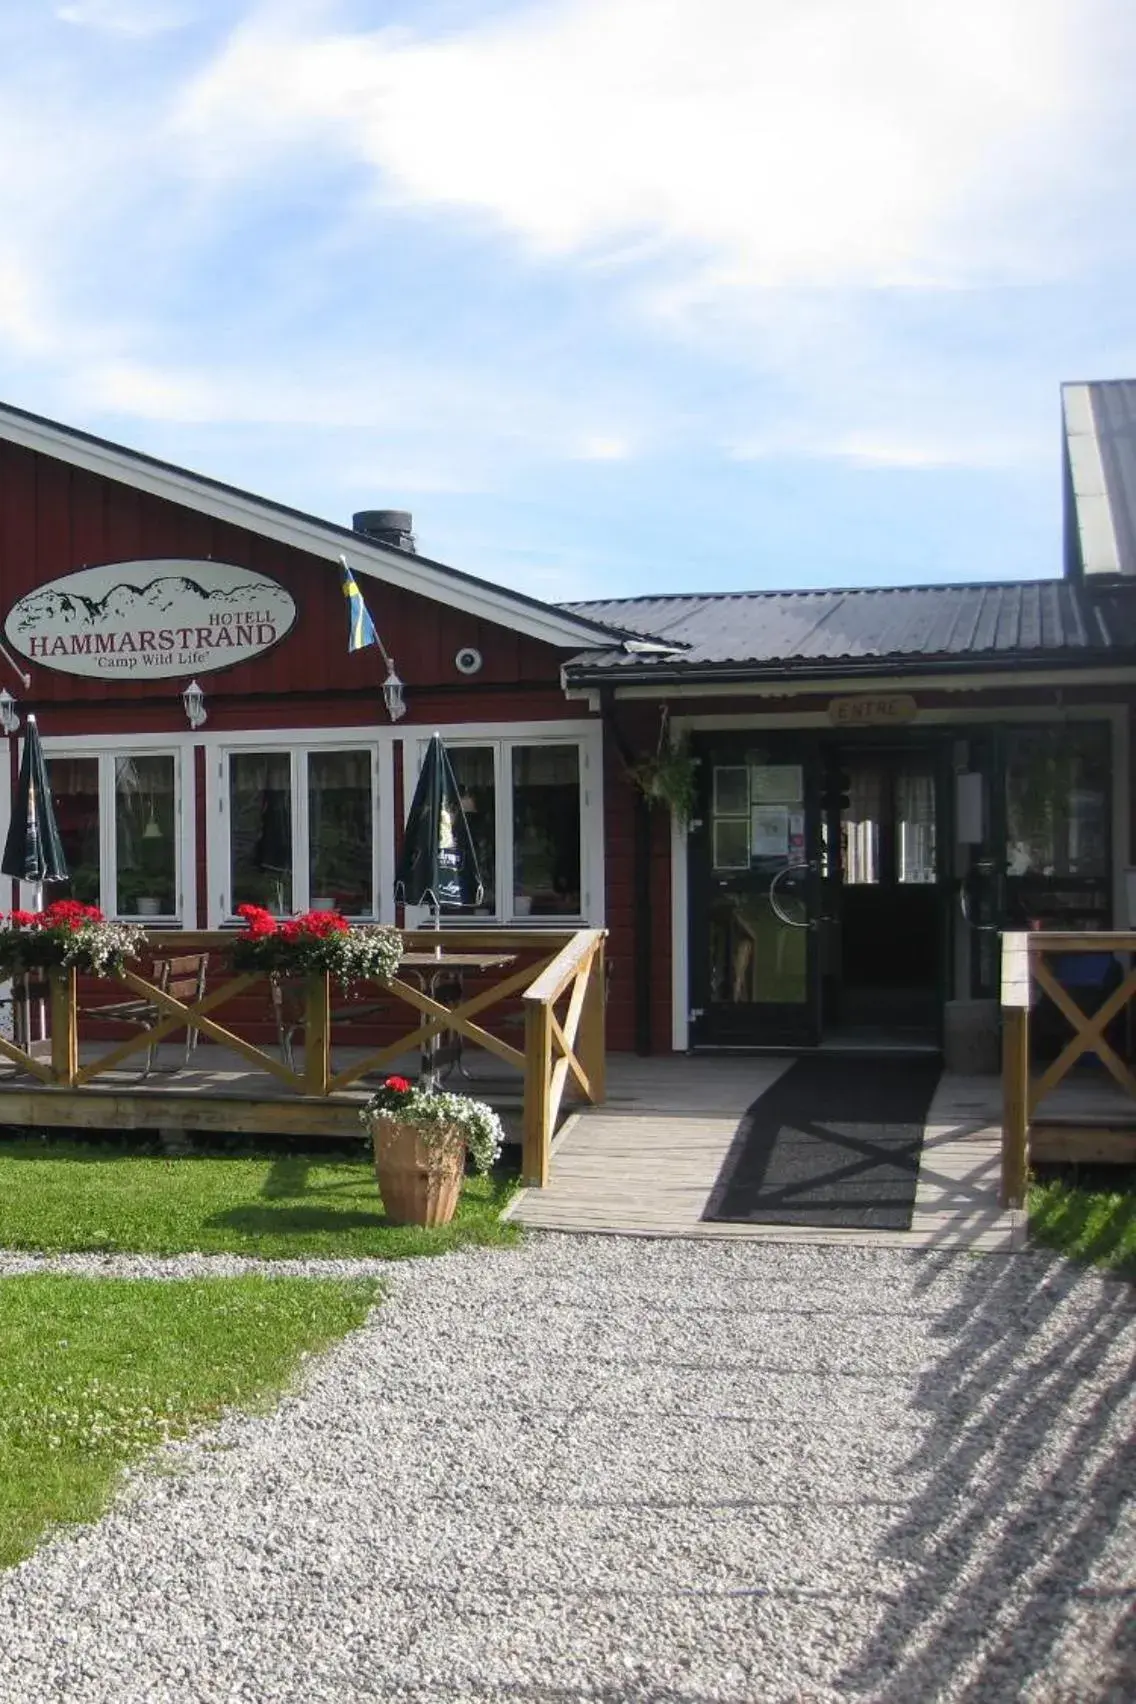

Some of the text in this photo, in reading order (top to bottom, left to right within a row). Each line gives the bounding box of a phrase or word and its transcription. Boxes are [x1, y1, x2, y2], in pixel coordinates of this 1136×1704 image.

[209, 611, 276, 627] HOTELL
[30, 624, 277, 657] HAMMARSTRAND
[143, 653, 173, 666] Wild
